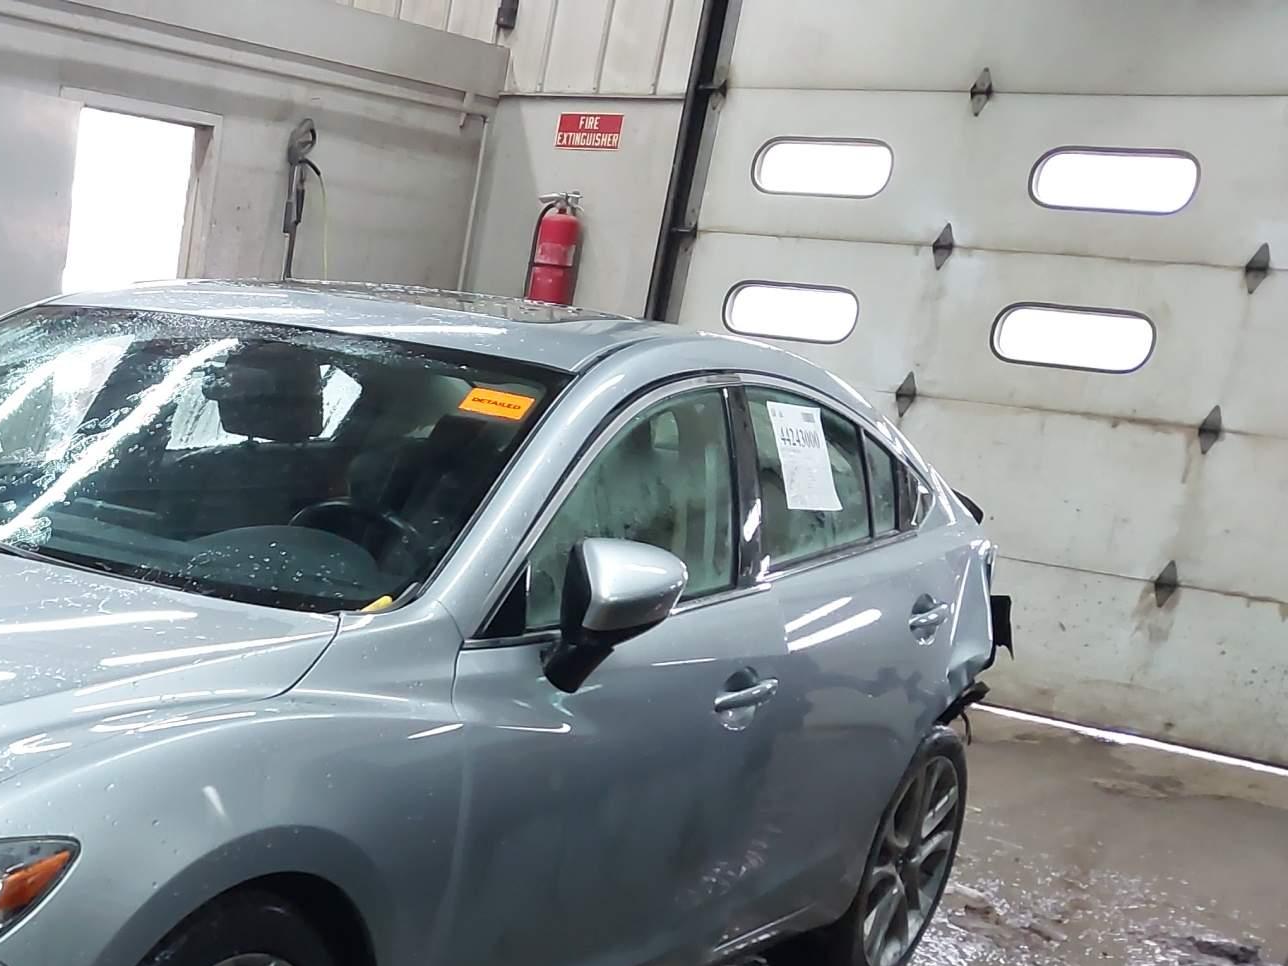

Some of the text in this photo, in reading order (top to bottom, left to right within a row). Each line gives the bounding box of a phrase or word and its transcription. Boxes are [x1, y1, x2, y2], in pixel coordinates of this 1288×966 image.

[578, 116, 601, 130] FIRE
[556, 132, 619, 147] EXTINGUISHER
[472, 397, 521, 410] DETAILED
[780, 426, 821, 449] 44243000
